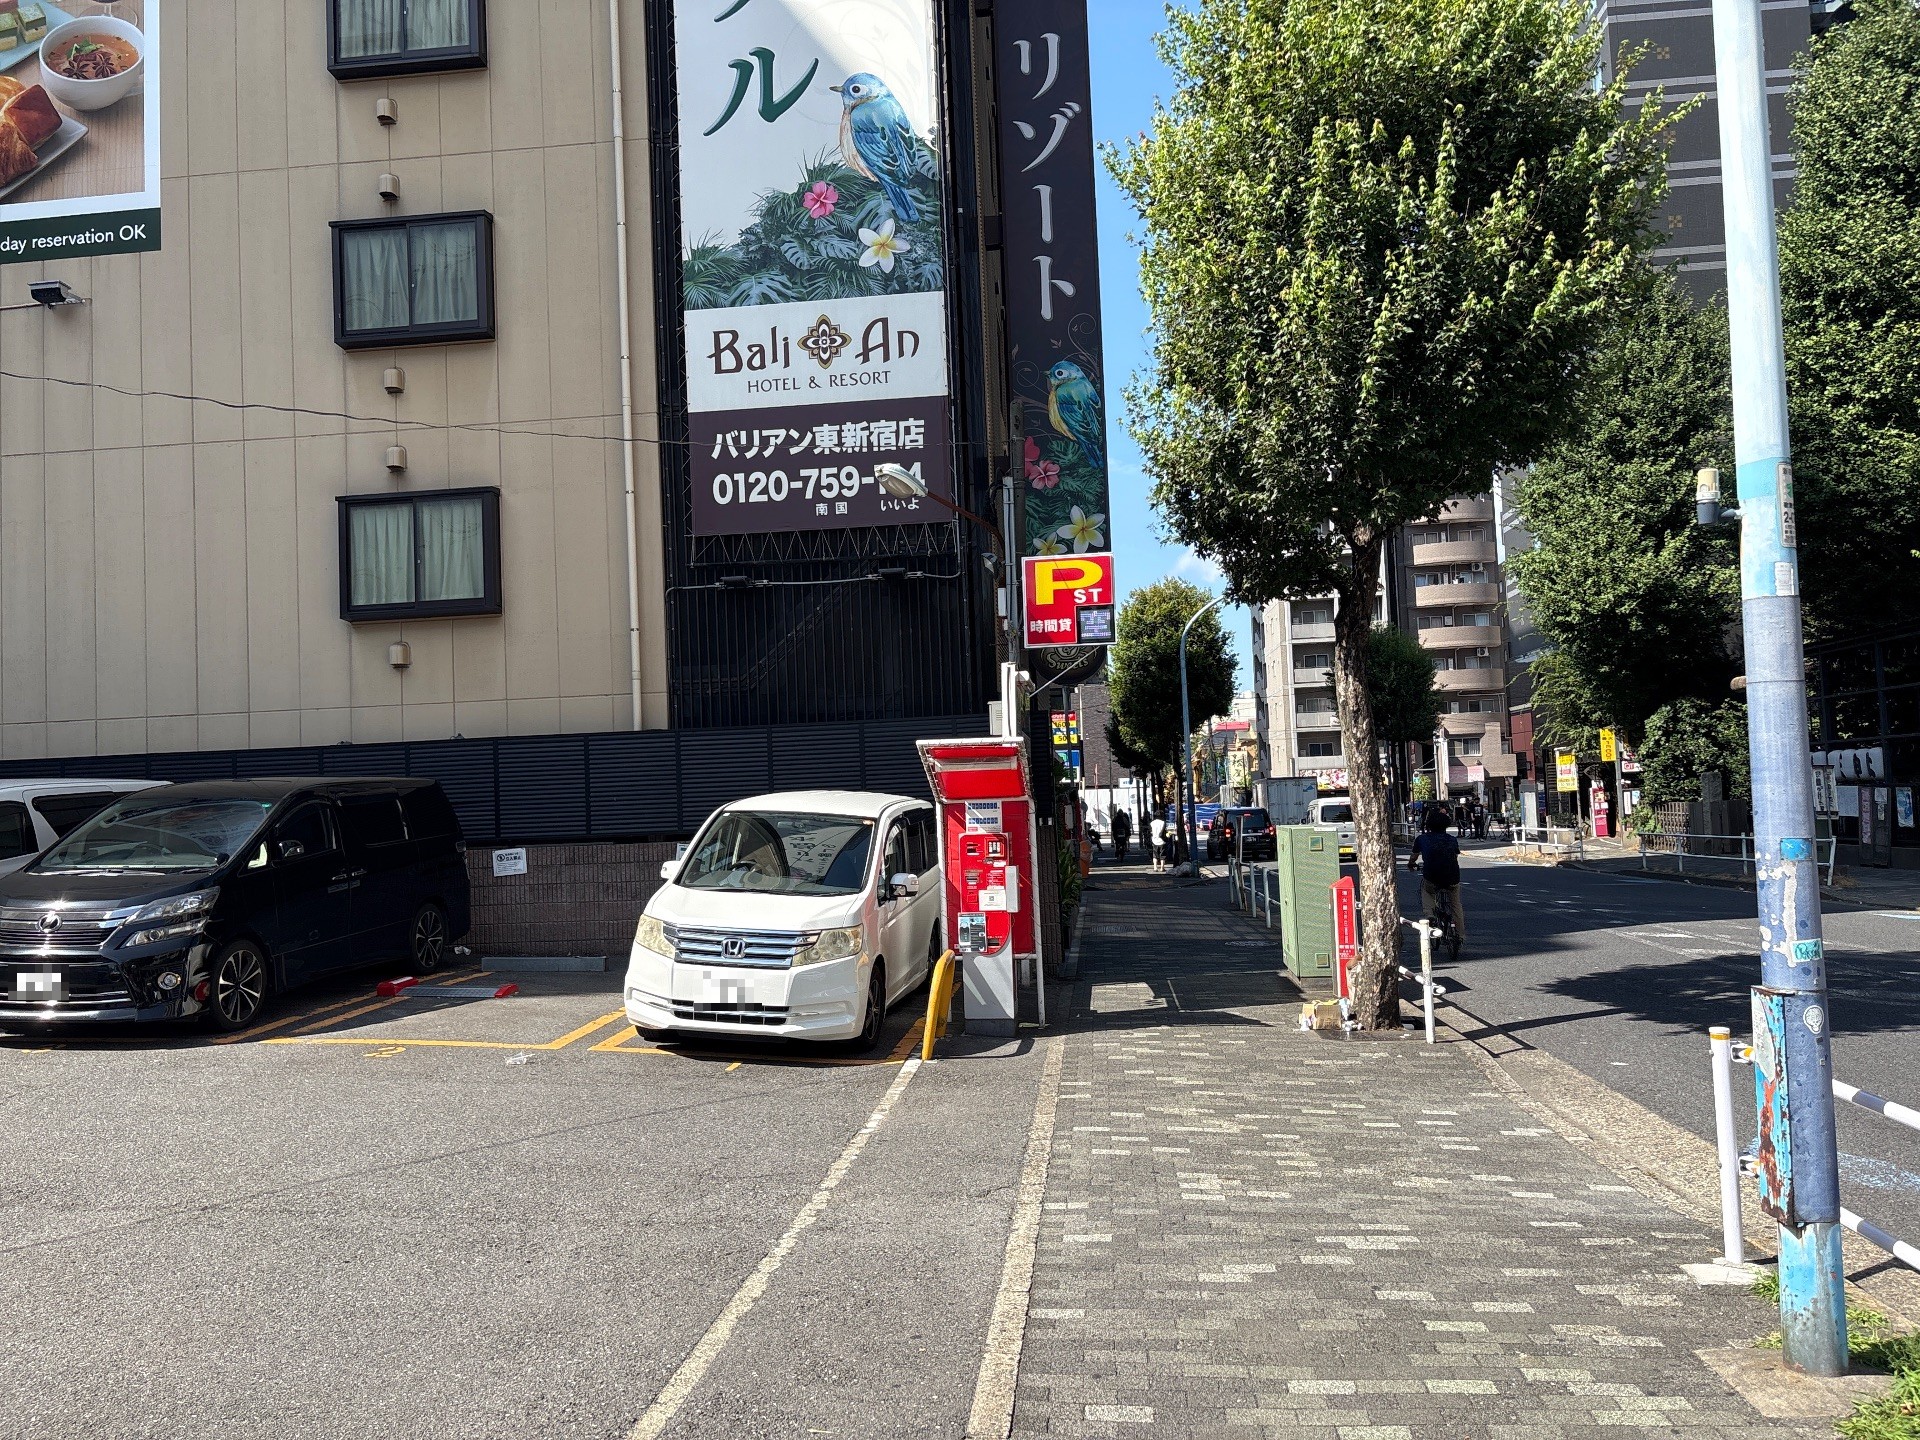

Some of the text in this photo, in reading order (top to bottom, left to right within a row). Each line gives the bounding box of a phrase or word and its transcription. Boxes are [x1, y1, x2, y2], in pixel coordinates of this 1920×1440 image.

[703, 0, 819, 136] ル
[1012, 32, 1081, 322] リゾート
[32, 228, 114, 249] reservation
[119, 223, 147, 241] OK
[706, 316, 920, 374] Bali An
[747, 370, 891, 393] HOTEL & RESORT
[711, 417, 925, 460] バリアン東新宿店
[880, 496, 920, 511] いいよ
[1034, 559, 1103, 605] P
[1074, 588, 1103, 604] ST
[1030, 618, 1072, 633] 時間貸
